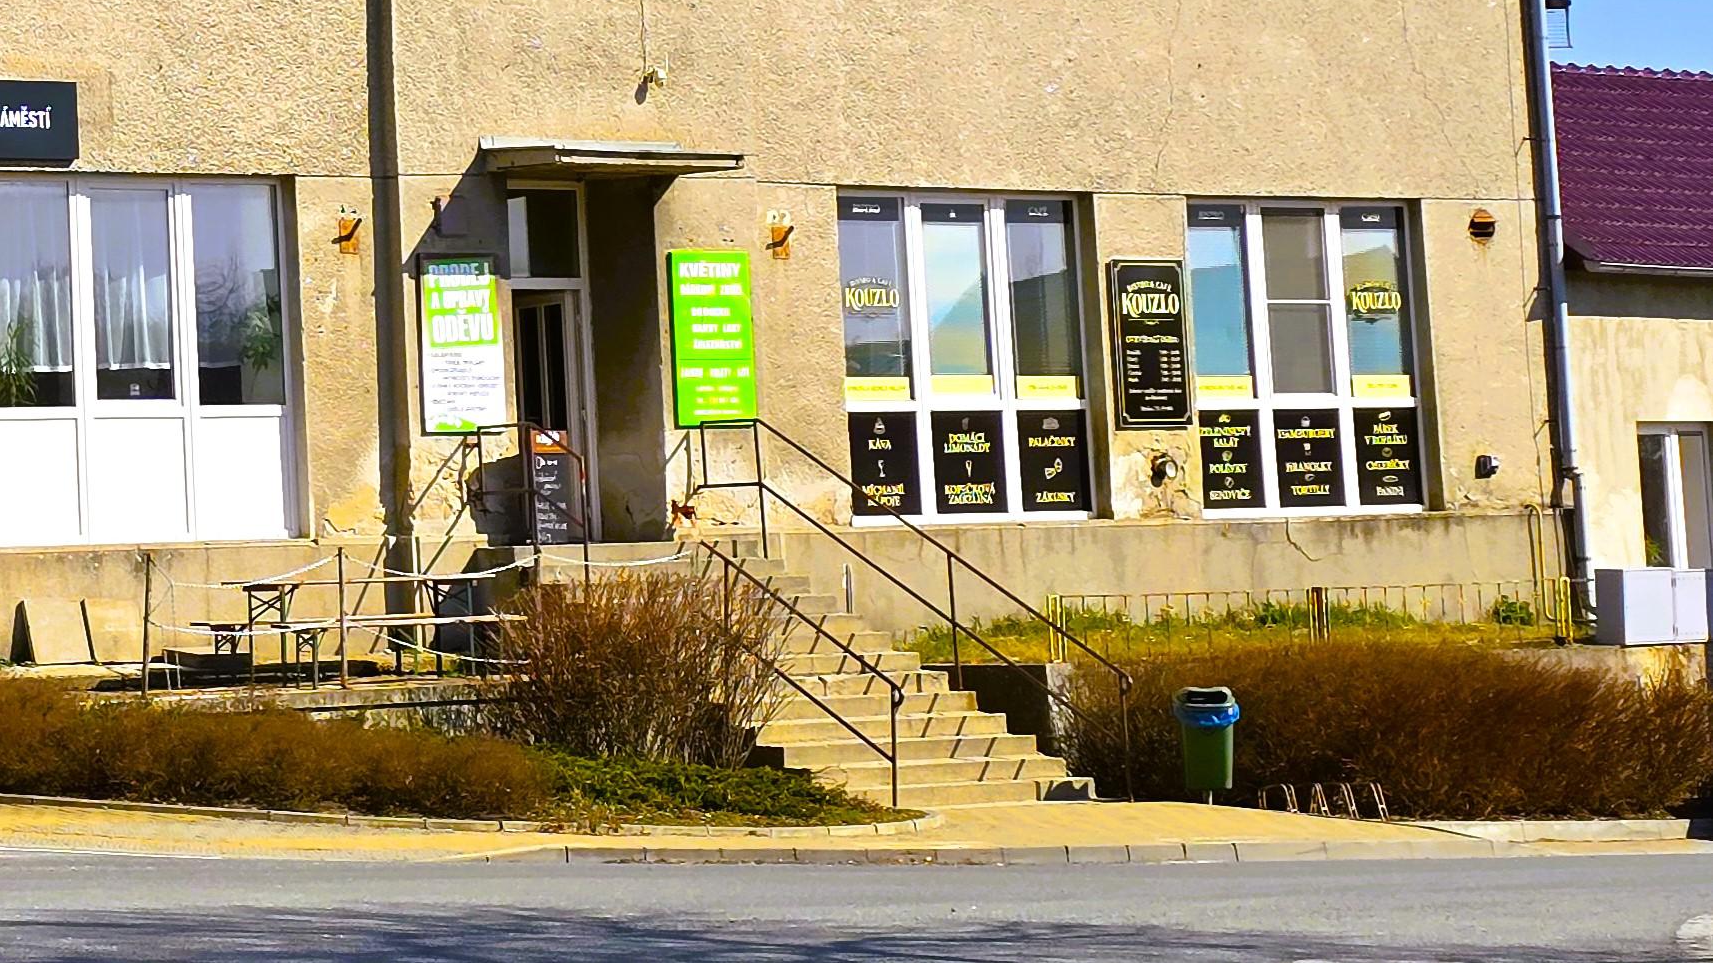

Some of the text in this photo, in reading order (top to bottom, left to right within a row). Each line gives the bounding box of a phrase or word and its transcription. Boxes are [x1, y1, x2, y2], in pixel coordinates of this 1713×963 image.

[678, 260, 742, 279] KVĚTINY
[430, 291, 441, 310] A
[845, 287, 900, 311] KOUZLO
[1122, 292, 1180, 318] KOUZLO
[1351, 291, 1402, 313] KOUZLO
[868, 437, 892, 450] KÁVA
